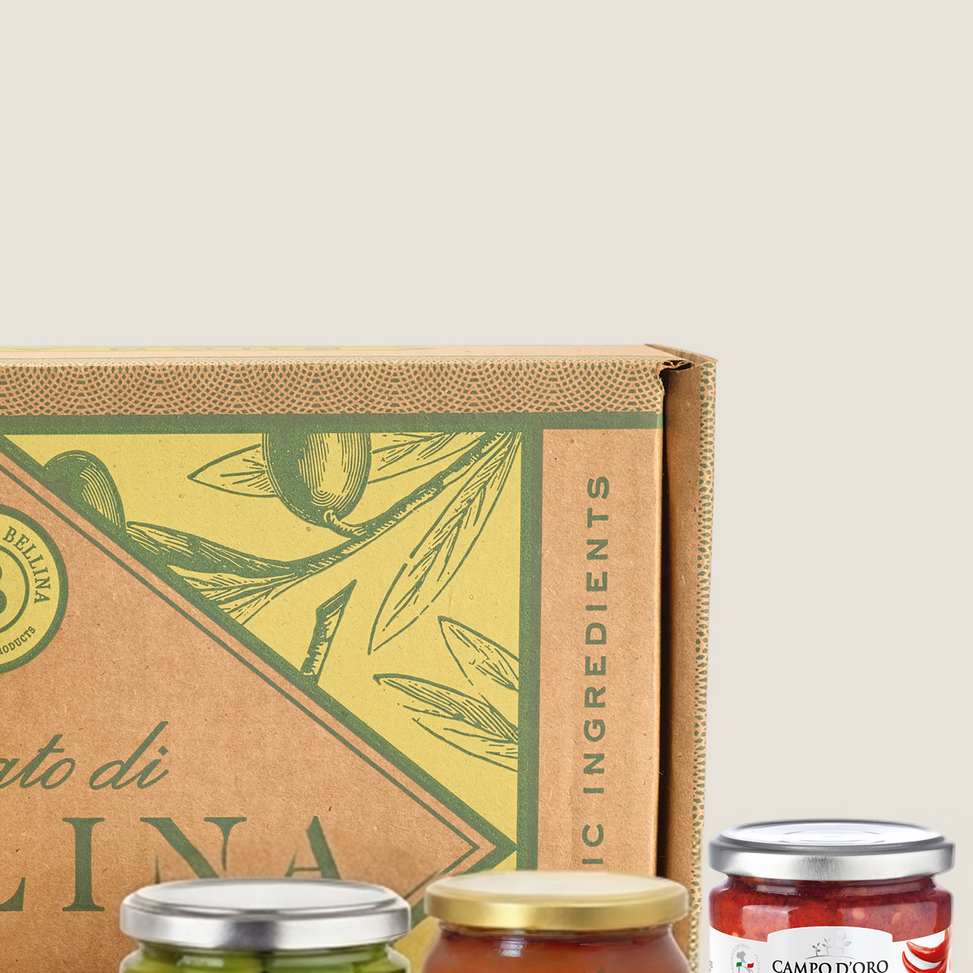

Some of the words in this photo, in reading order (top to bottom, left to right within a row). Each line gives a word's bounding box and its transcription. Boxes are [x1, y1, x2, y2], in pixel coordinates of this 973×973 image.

[2, 525, 51, 605] BELLINA
[583, 475, 610, 794] INGREDIENTS
[89, 720, 169, 790] di
